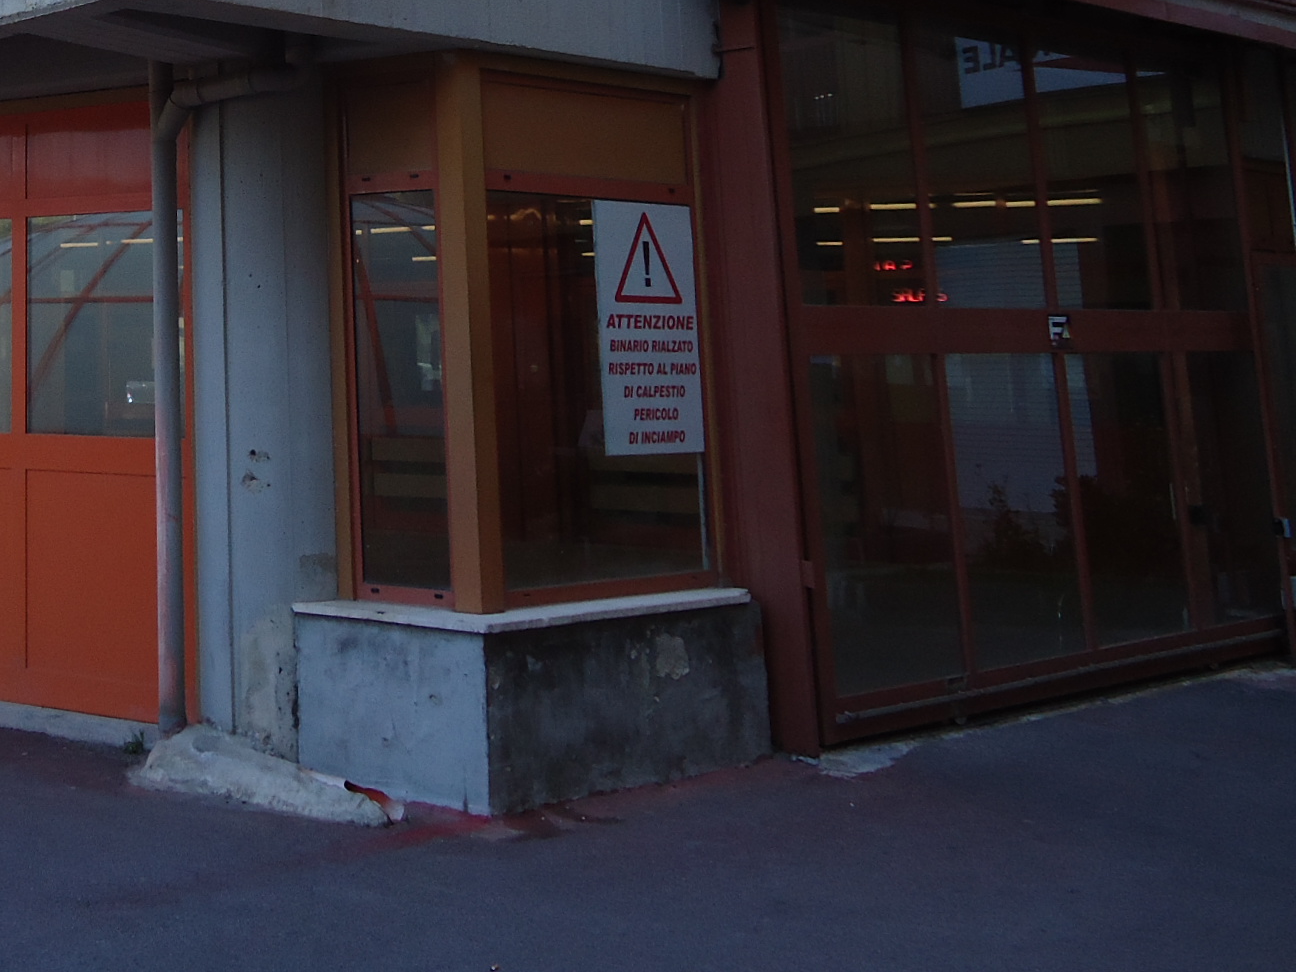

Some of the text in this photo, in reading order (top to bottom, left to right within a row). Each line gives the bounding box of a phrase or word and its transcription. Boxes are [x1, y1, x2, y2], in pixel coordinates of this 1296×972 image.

[606, 314, 694, 330] ATTENZIONE
[610, 339, 694, 353] BINARIO RIALZATO
[609, 362, 697, 375] RISPETTO AL PIANO
[624, 385, 685, 398] DI CALPESTIO
[634, 408, 679, 421] PERICOLO
[629, 430, 685, 444] DI INCIAMPO
